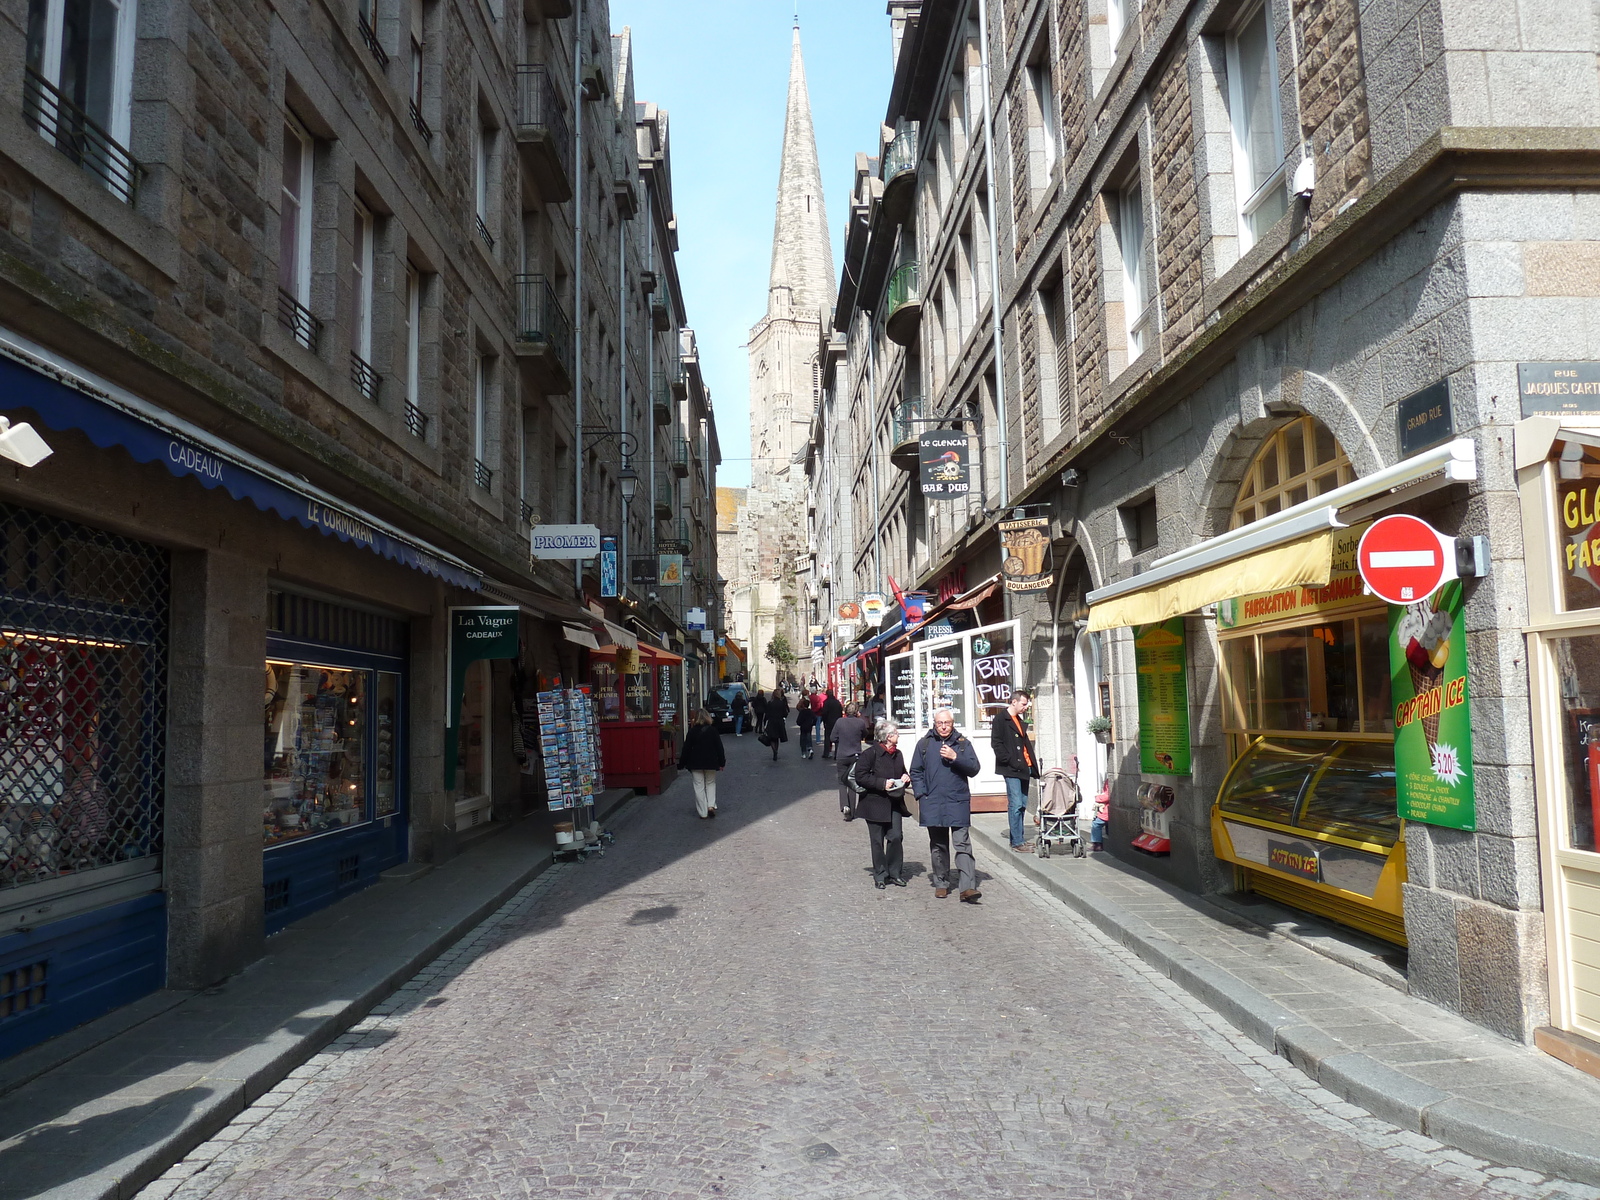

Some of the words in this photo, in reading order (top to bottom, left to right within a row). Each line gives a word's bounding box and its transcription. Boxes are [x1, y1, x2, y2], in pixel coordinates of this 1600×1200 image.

[1523, 382, 1570, 396] JACQUES
[1407, 412, 1428, 430] GRAND
[1429, 405, 1442, 421] RUE
[932, 438, 968, 447] GLENCAR
[169, 441, 223, 481] CADEAUX
[922, 483, 943, 492] BAR
[948, 483, 969, 493] PUB
[307, 500, 320, 522] LE
[323, 507, 374, 544] CORMORAN
[1003, 519, 1043, 530] PATISSERIE
[534, 535, 597, 549] PROMER
[1337, 535, 1361, 555] Sorbe
[1007, 579, 1052, 590] BOULANGERIE
[1244, 590, 1297, 619] FABRICATION
[1301, 574, 1363, 608] ARTISANALE
[458, 616, 475, 626] La
[477, 615, 513, 628] Vague
[466, 631, 502, 639] CADEAUX
[935, 663, 955, 671] Cidre
[975, 658, 1011, 679] BAR
[976, 683, 1011, 700] PUB
[1395, 685, 1443, 728] CAPTAIN
[1445, 676, 1466, 709] ICE
[1408, 772, 1420, 781] CÔNE
[1413, 783, 1429, 792] BOULES
[1410, 791, 1432, 801] MONTAGNE
[1438, 796, 1461, 806] CHANTILLY
[1410, 800, 1431, 810] CHOCOLAT
[1431, 804, 1447, 813] CHAUD
[1410, 809, 1428, 819] PRALINE
